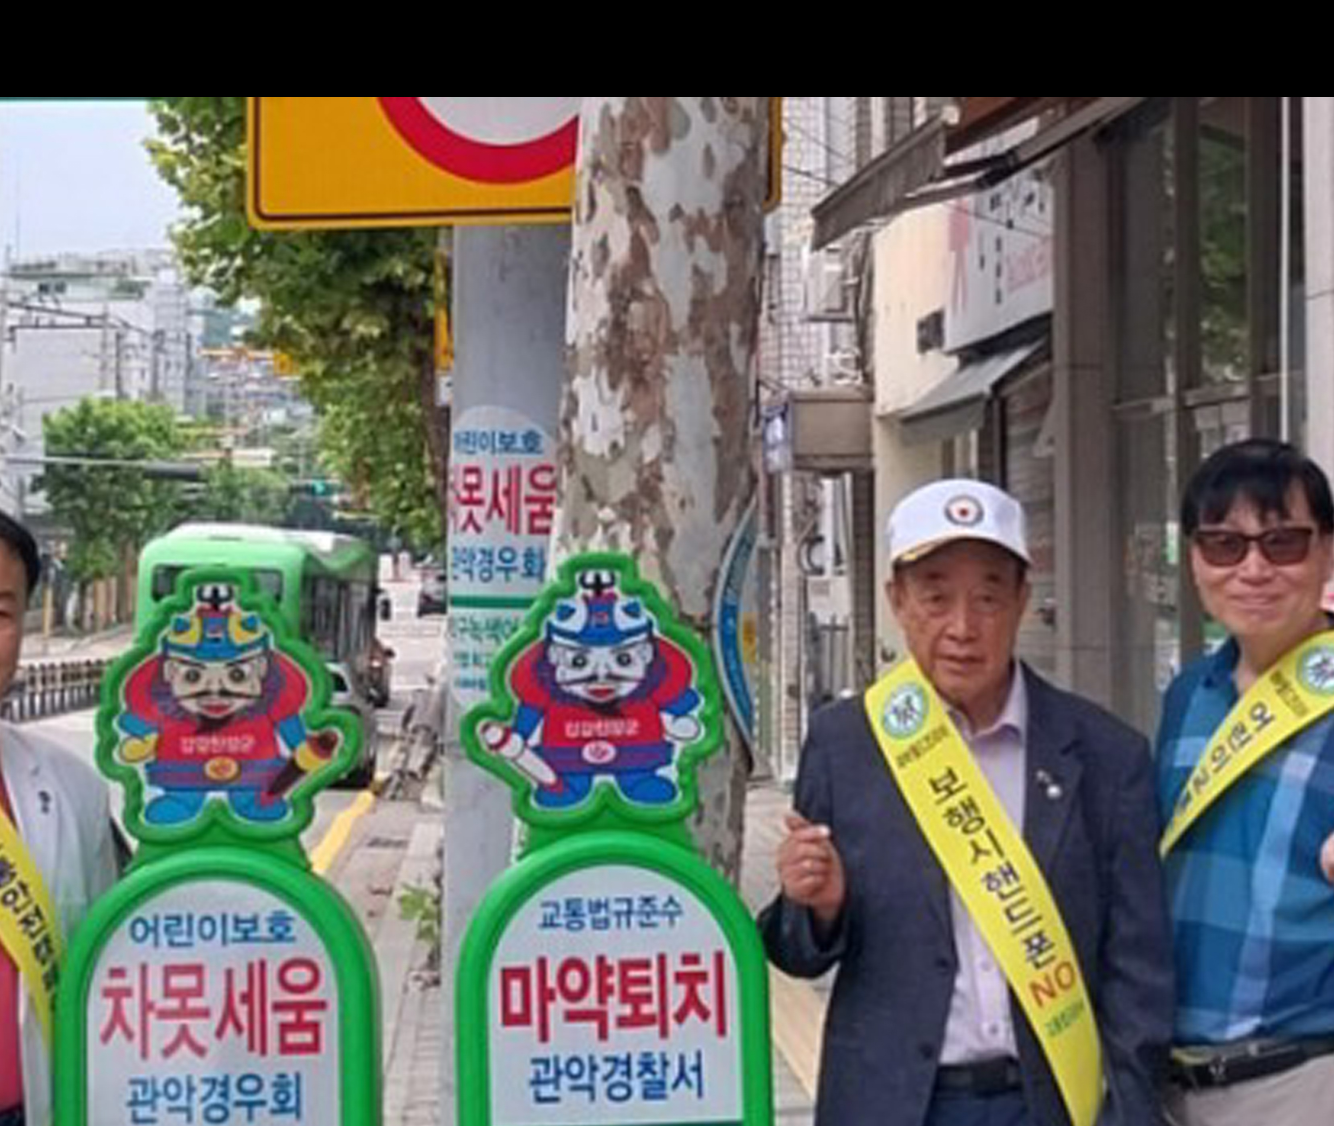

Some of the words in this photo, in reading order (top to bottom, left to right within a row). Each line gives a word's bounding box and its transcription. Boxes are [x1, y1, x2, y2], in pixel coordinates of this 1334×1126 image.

[129, 911, 297, 948] 어린이보호
[538, 896, 684, 933] 교통법규준수
[100, 957, 328, 1060] 차못세움
[500, 950, 727, 1044] 마약퇴치
[1030, 958, 1077, 1008] NO
[125, 1072, 304, 1125] 관악경우회
[529, 1050, 705, 1103] 관악경찰서
